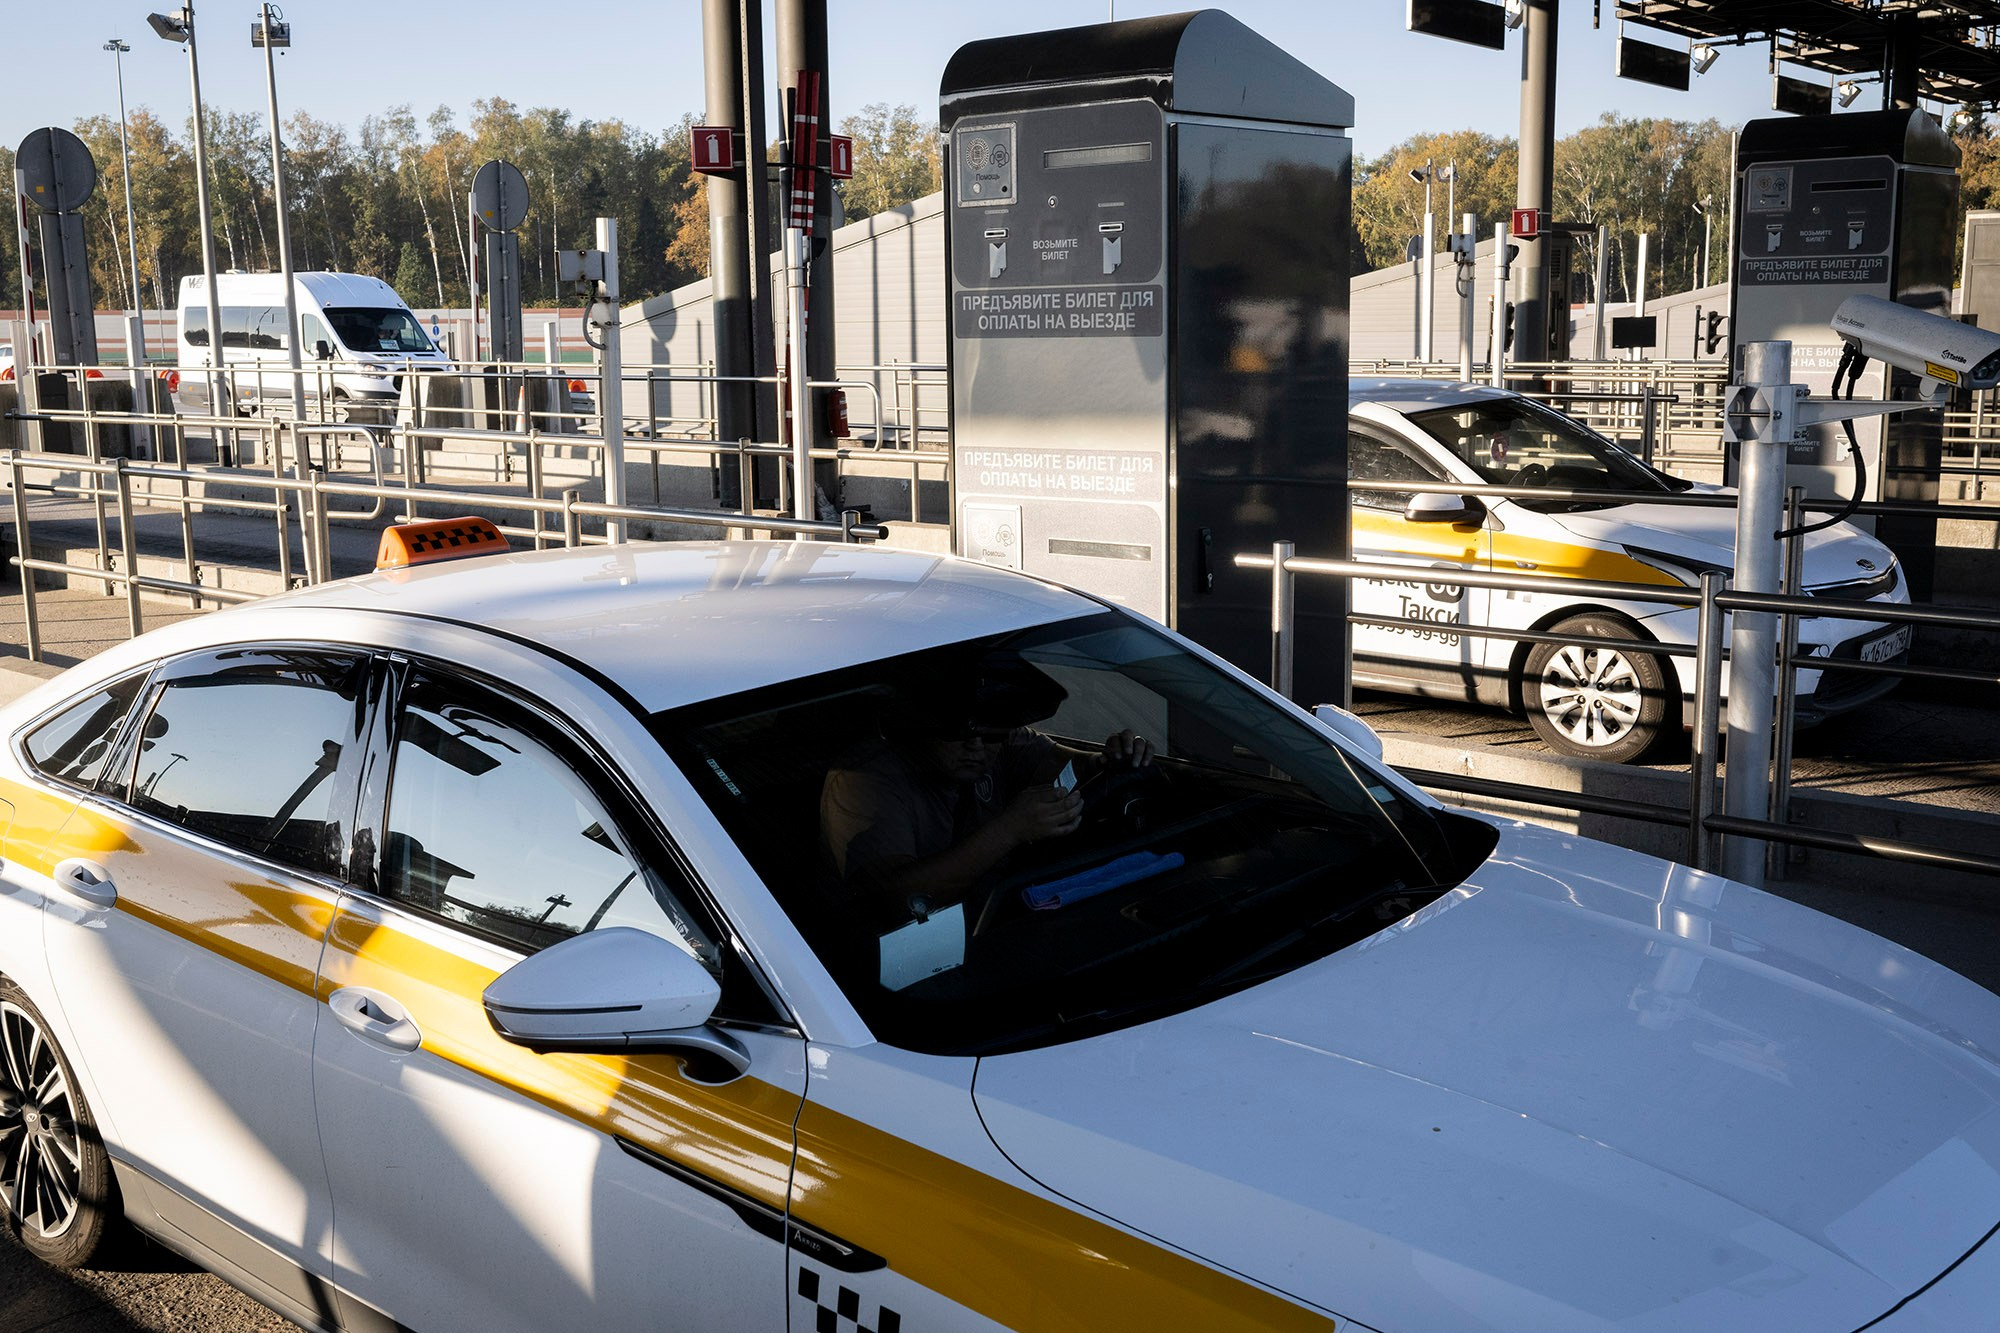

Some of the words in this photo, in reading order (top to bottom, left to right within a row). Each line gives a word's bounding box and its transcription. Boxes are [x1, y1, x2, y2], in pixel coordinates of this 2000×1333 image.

[975, 173, 1000, 182] Помощь
[1032, 238, 1078, 250] ВОЗЬМИТЕ
[1041, 251, 1069, 261] БИЛЕТ
[1745, 260, 1818, 271] ПРЕДЪЯВИТЕ
[1820, 259, 1856, 269] БИЛЕТ
[1859, 258, 1883, 269] ДЛЯ
[1756, 271, 1802, 281] ОПЛАТЫ
[1805, 271, 1820, 280] НА
[1823, 270, 1870, 281] ВЫЕЗДЕ
[962, 294, 1061, 312] ПРЕДЪЯВИТЕ
[1065, 292, 1116, 308] БИЛЕТ
[1120, 291, 1154, 310] ДЛЯ
[978, 315, 1040, 330] ОПЛАТЫ
[1045, 314, 1066, 329] НА
[1070, 312, 1136, 331] ВЫЕЗДЕ
[1801, 359, 1816, 367] НА
[964, 451, 1061, 469] ПРЕДЪЯВИТЕ
[1066, 454, 1116, 471] БИЛЕТ
[1120, 456, 1153, 473] ДЛЯ
[980, 471, 1042, 487] ОПЛАТЫ
[1046, 473, 1066, 489] НА
[1070, 475, 1136, 495] ВЫЕЗДЕ
[982, 548, 1006, 558] Помощь
[1398, 594, 1460, 625] Такси
